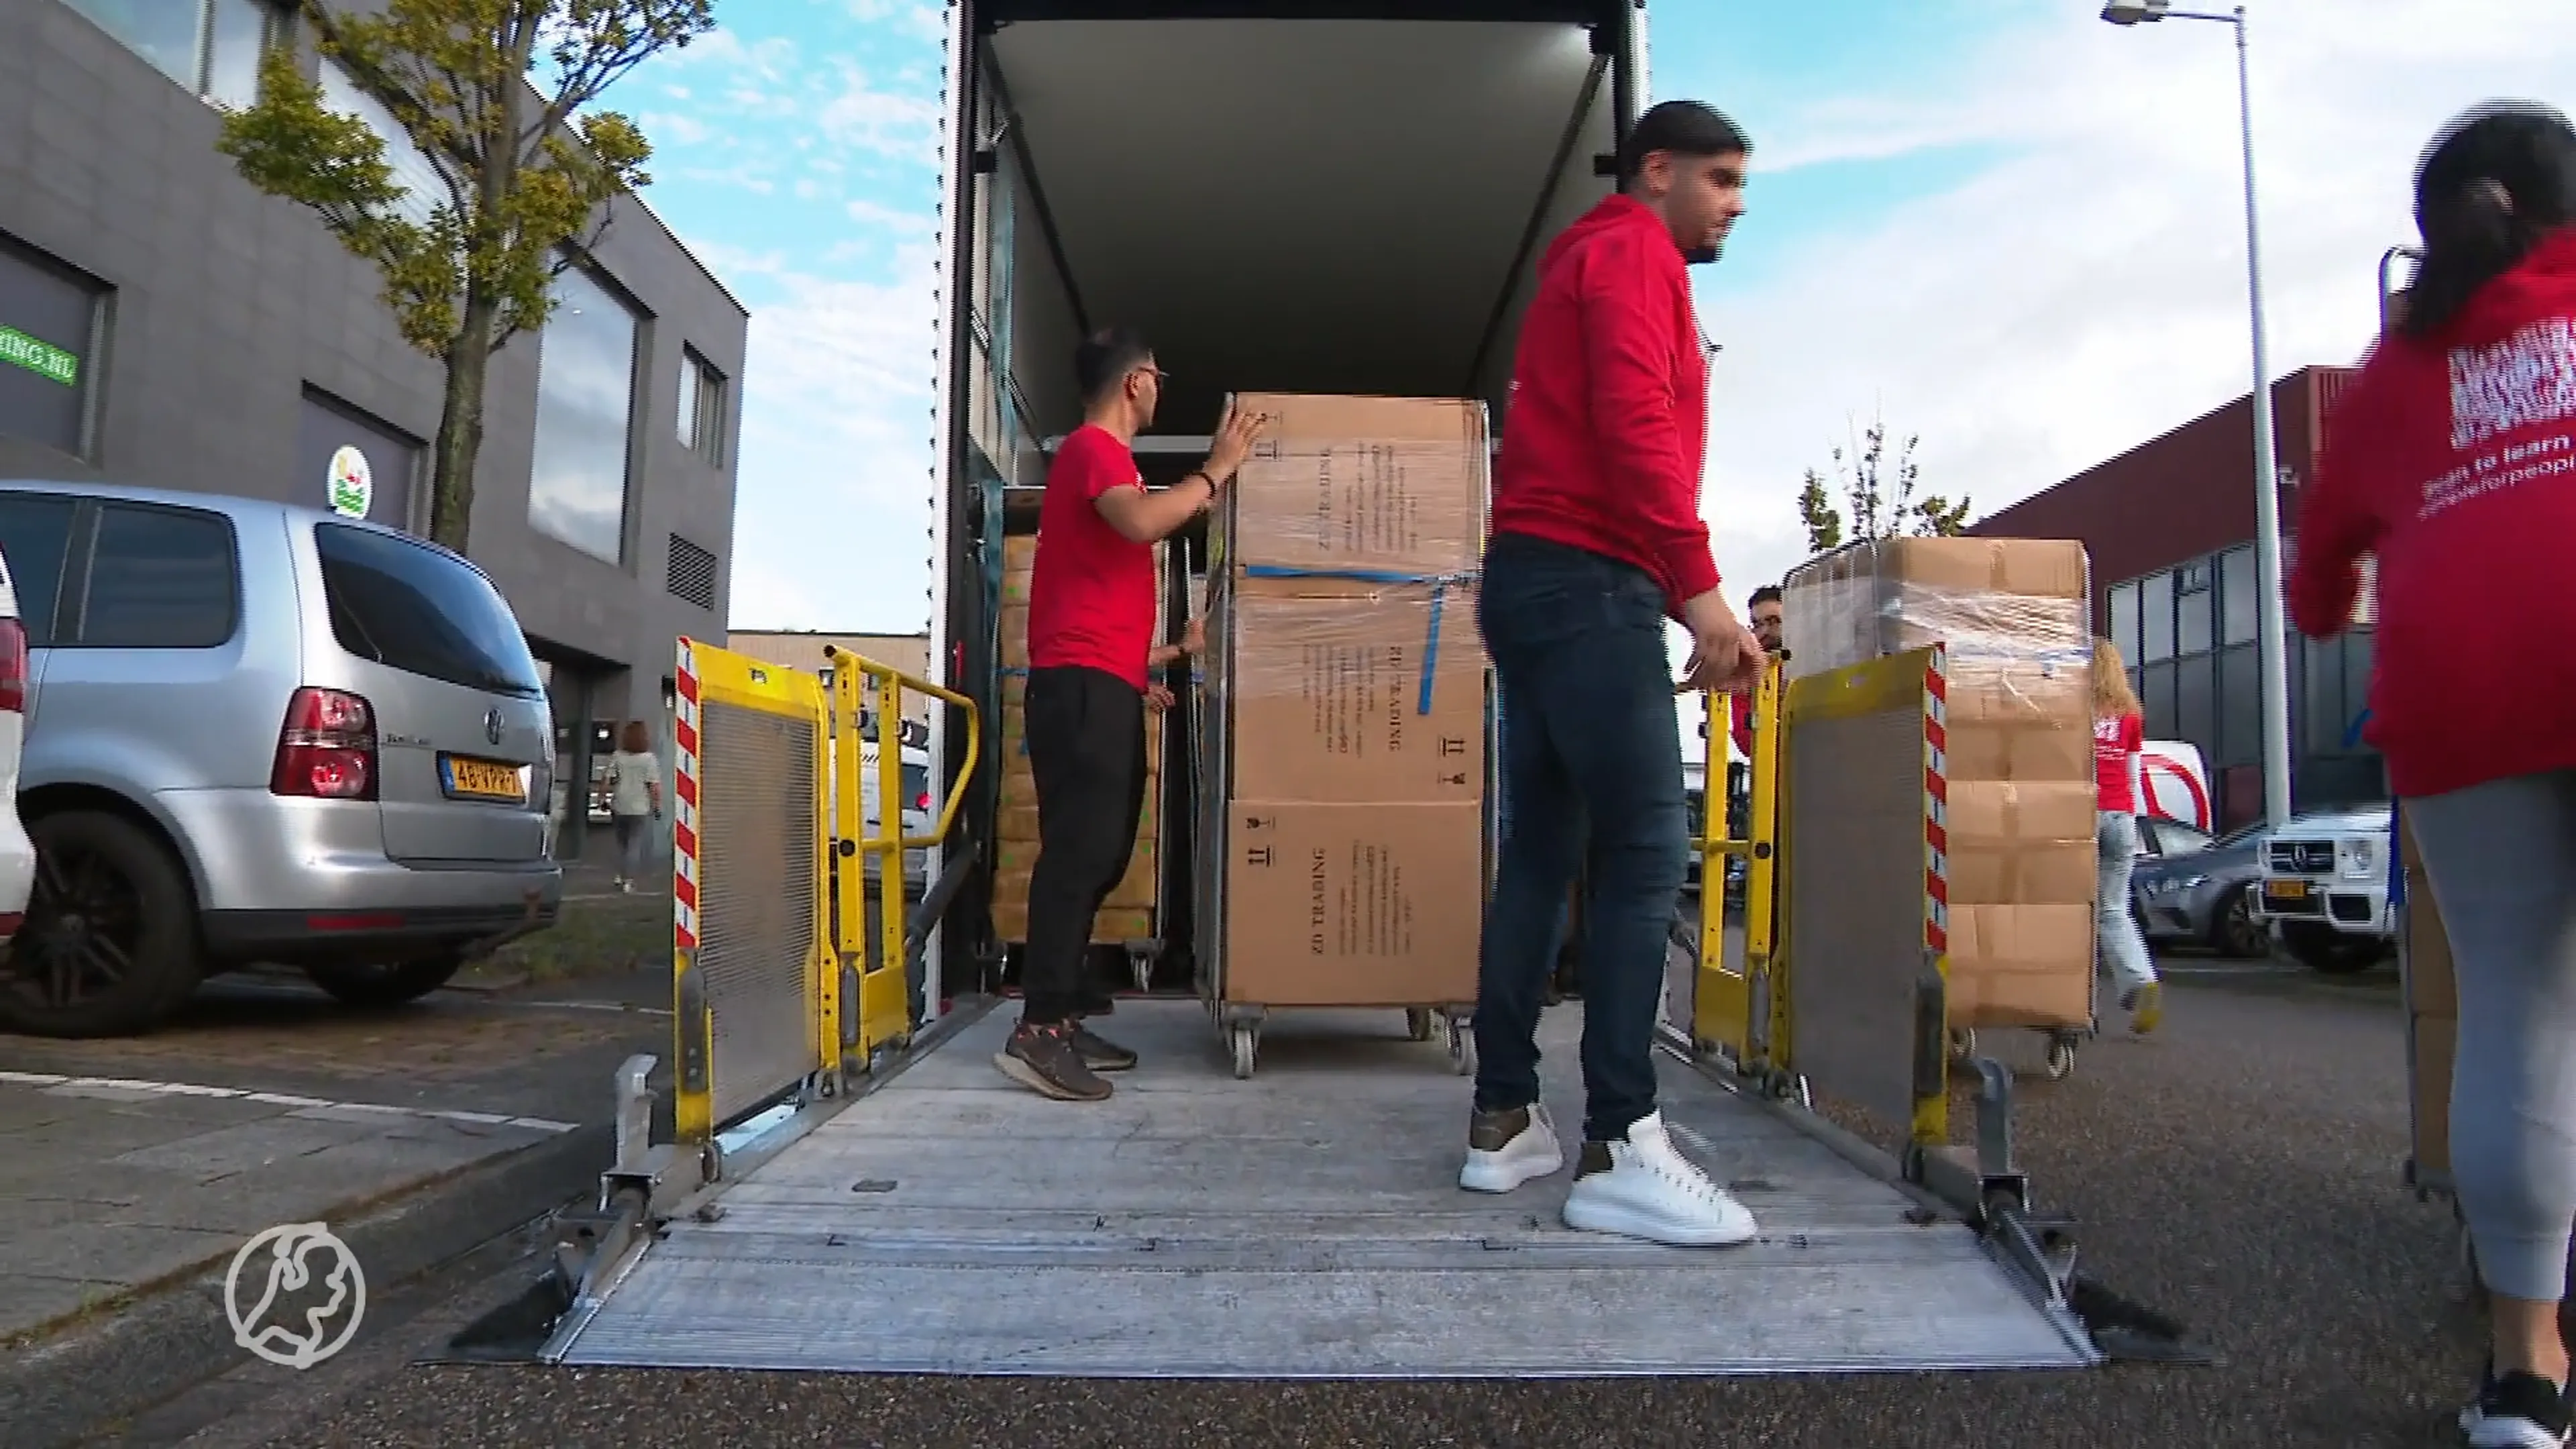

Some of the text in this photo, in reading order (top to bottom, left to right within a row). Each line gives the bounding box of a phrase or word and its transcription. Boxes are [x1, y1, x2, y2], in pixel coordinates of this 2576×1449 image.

[2474, 433, 2569, 473] to learn
[1311, 848, 1326, 928] TRADING
